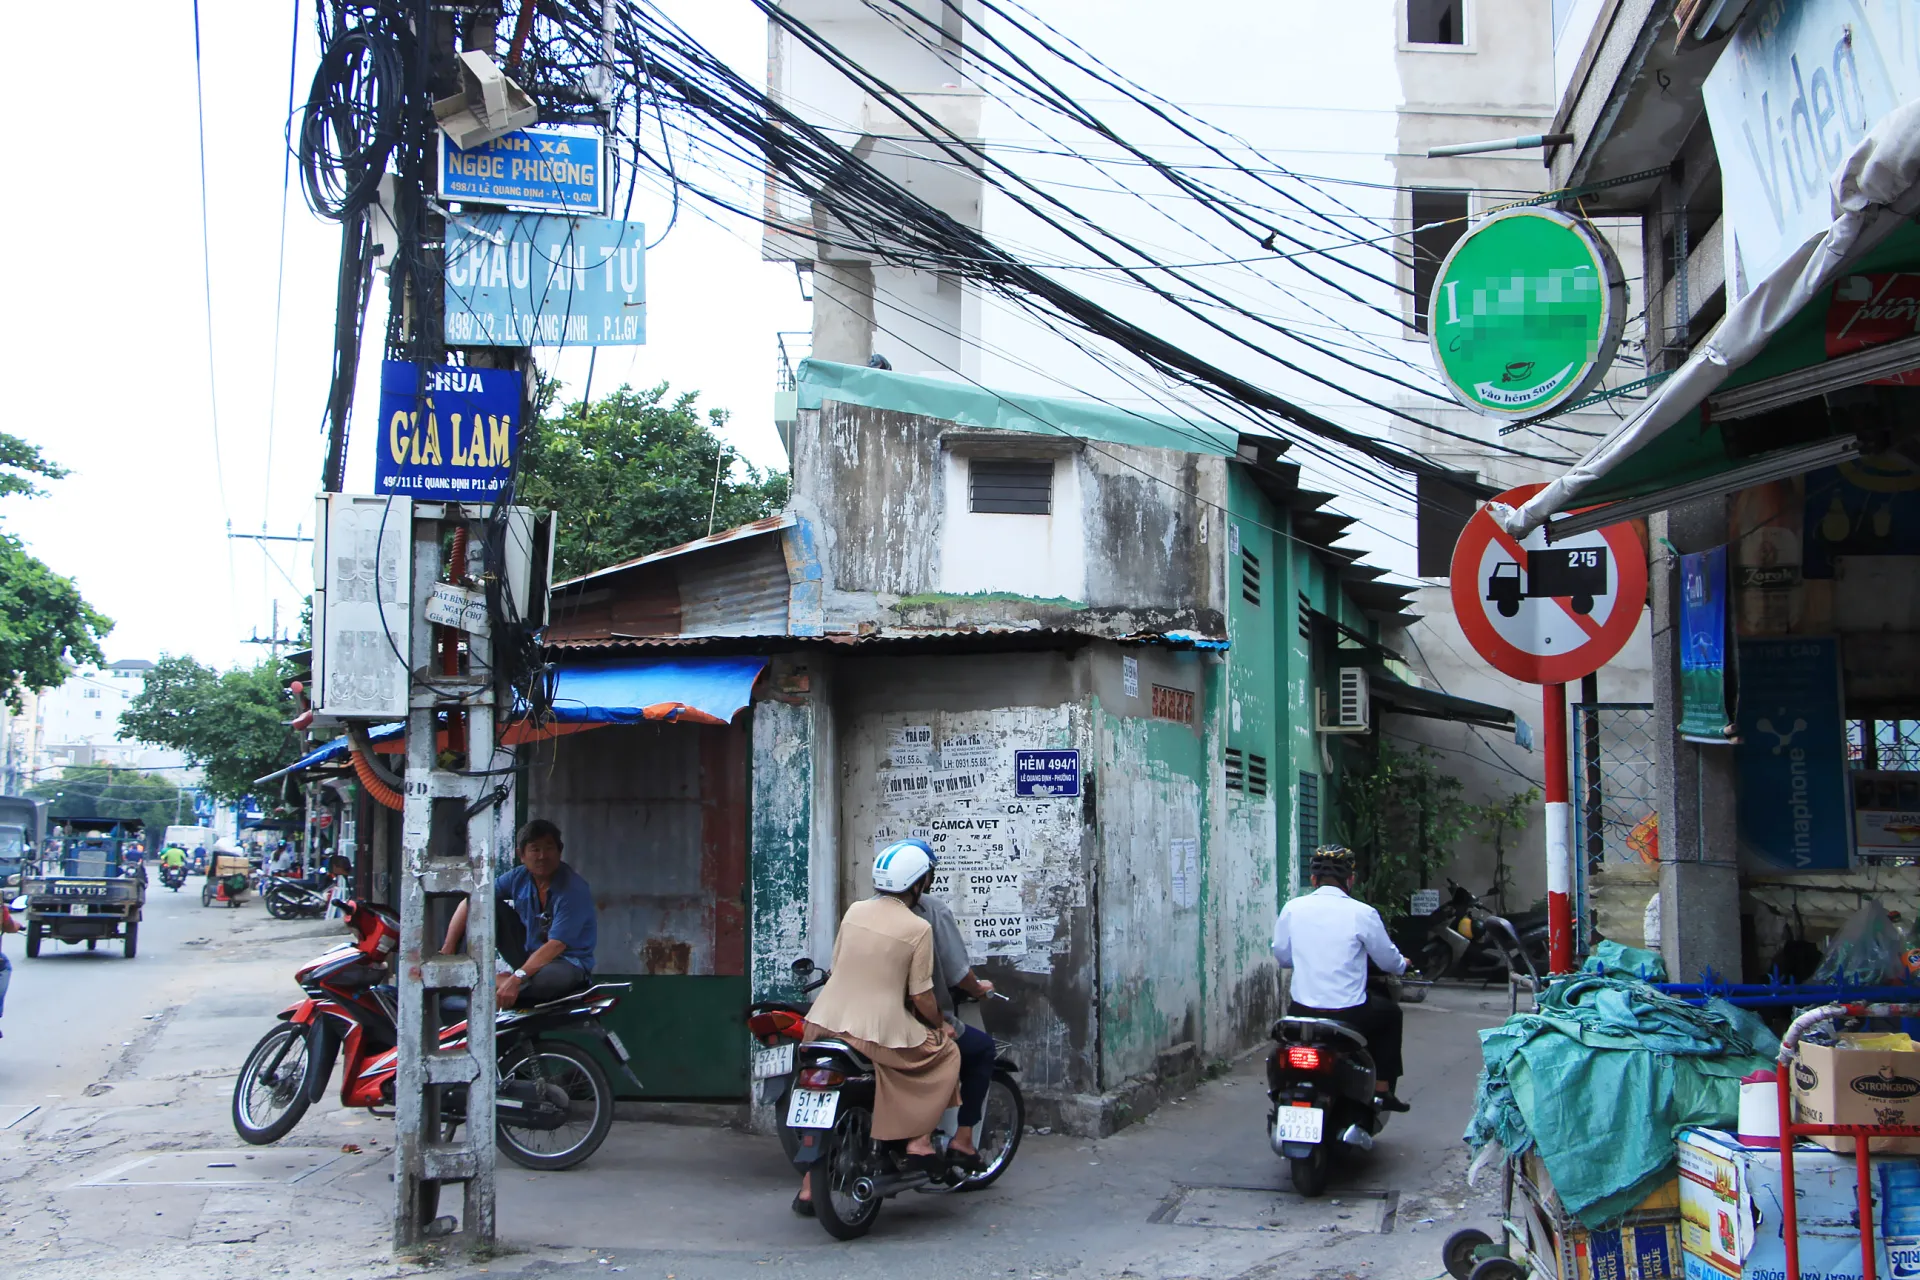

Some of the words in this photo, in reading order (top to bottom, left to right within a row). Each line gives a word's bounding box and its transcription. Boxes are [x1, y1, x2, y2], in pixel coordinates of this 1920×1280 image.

[539, 139, 571, 155] XÁ
[1741, 37, 1866, 237] Video
[449, 152, 504, 181] NGỌC
[512, 157, 594, 186] PHƯƠNG
[450, 181, 477, 193] 498/1
[493, 185, 521, 197] QUANG
[449, 229, 530, 290] CHÂU
[547, 244, 586, 291] AN
[599, 239, 641, 303] TỰ
[505, 308, 519, 340] LÊ
[522, 314, 559, 344] QUANG
[425, 367, 484, 393] CHÙA
[1481, 388, 1501, 401] vào
[1532, 380, 1556, 397] 50m
[390, 398, 443, 466] GIÀ
[451, 413, 511, 468] LAM
[1019, 755, 1045, 770] HẺM
[1048, 758, 1076, 770] 494/1
[1788, 747, 1814, 867] vinaphone
[970, 875, 993, 884] CHO
[996, 874, 1018, 883] VAY
[974, 918, 997, 927] CHO
[999, 917, 1021, 926] VAY
[999, 925, 1022, 937] GÓP
[1859, 1081, 1918, 1093] STRONGBOW
